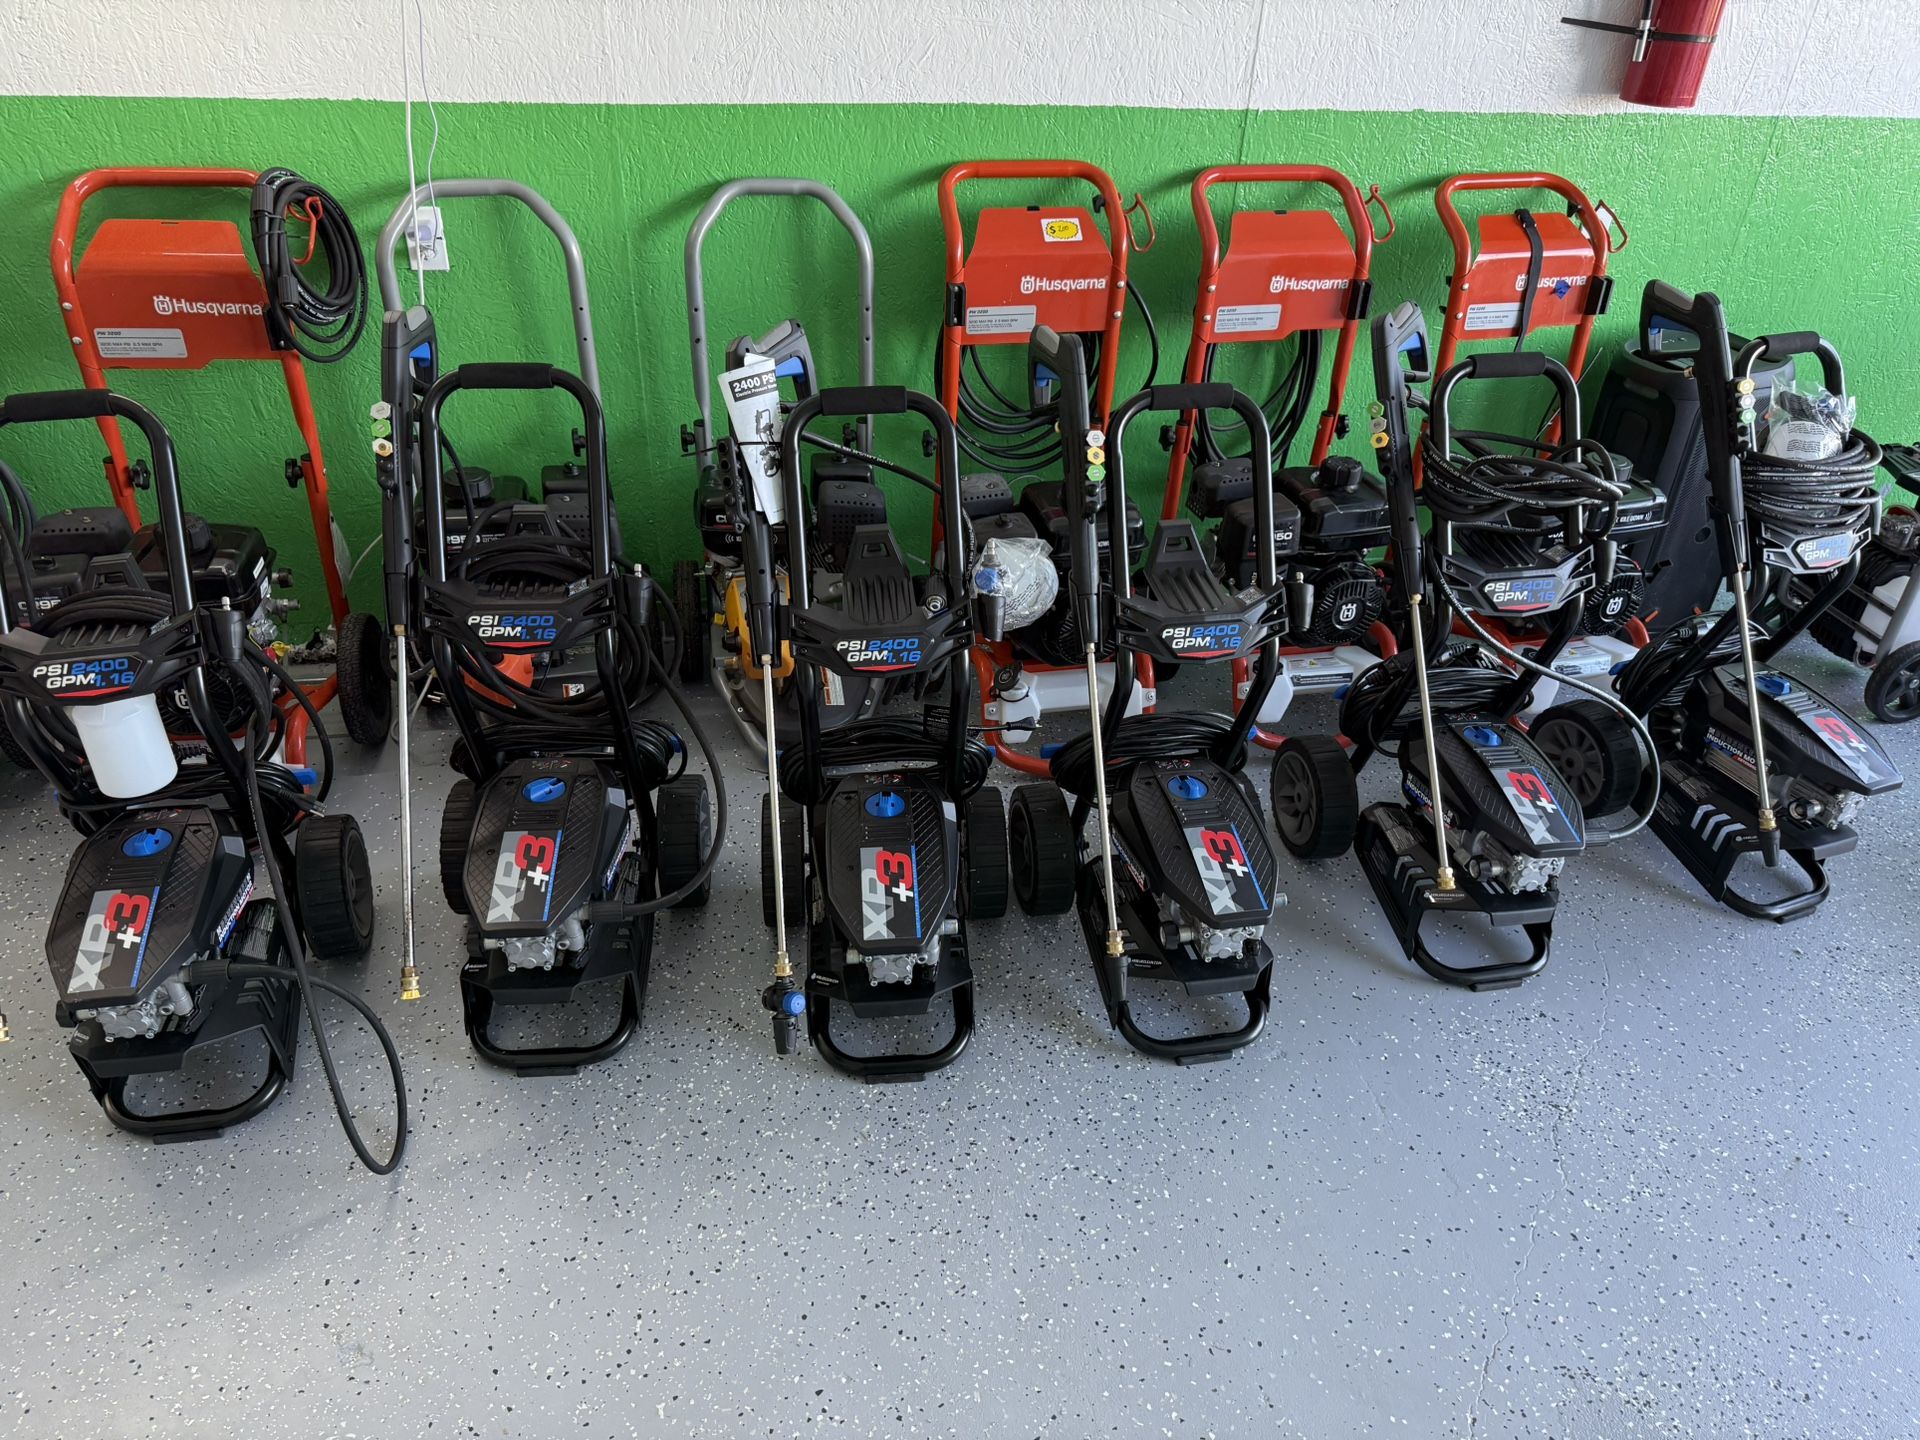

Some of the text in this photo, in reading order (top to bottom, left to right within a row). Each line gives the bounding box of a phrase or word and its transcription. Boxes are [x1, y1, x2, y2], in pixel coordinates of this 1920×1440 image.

[1035, 277, 1106, 292] Husqvarna
[1284, 277, 1349, 292] Husqvarna
[173, 298, 263, 316] Husqvarna
[733, 377, 760, 392] 2400
[1796, 541, 1816, 554] PSI
[1804, 548, 1830, 560] GPM
[1484, 580, 1554, 592] PSI 2400
[1493, 591, 1528, 602] GPM
[468, 615, 554, 626] PSI 2400
[478, 626, 557, 640] GPM 1.16
[1162, 624, 1240, 639] PSI 2400
[836, 638, 919, 652] PSI 2400
[1172, 636, 1242, 649] GPM 1.16
[846, 650, 922, 663] GPM 1.16
[33, 658, 129, 678] PSI 2400
[46, 671, 136, 689] GPM 1.16
[1706, 732, 1744, 757] INDUCTION
[1406, 779, 1432, 807] INDUCTION
